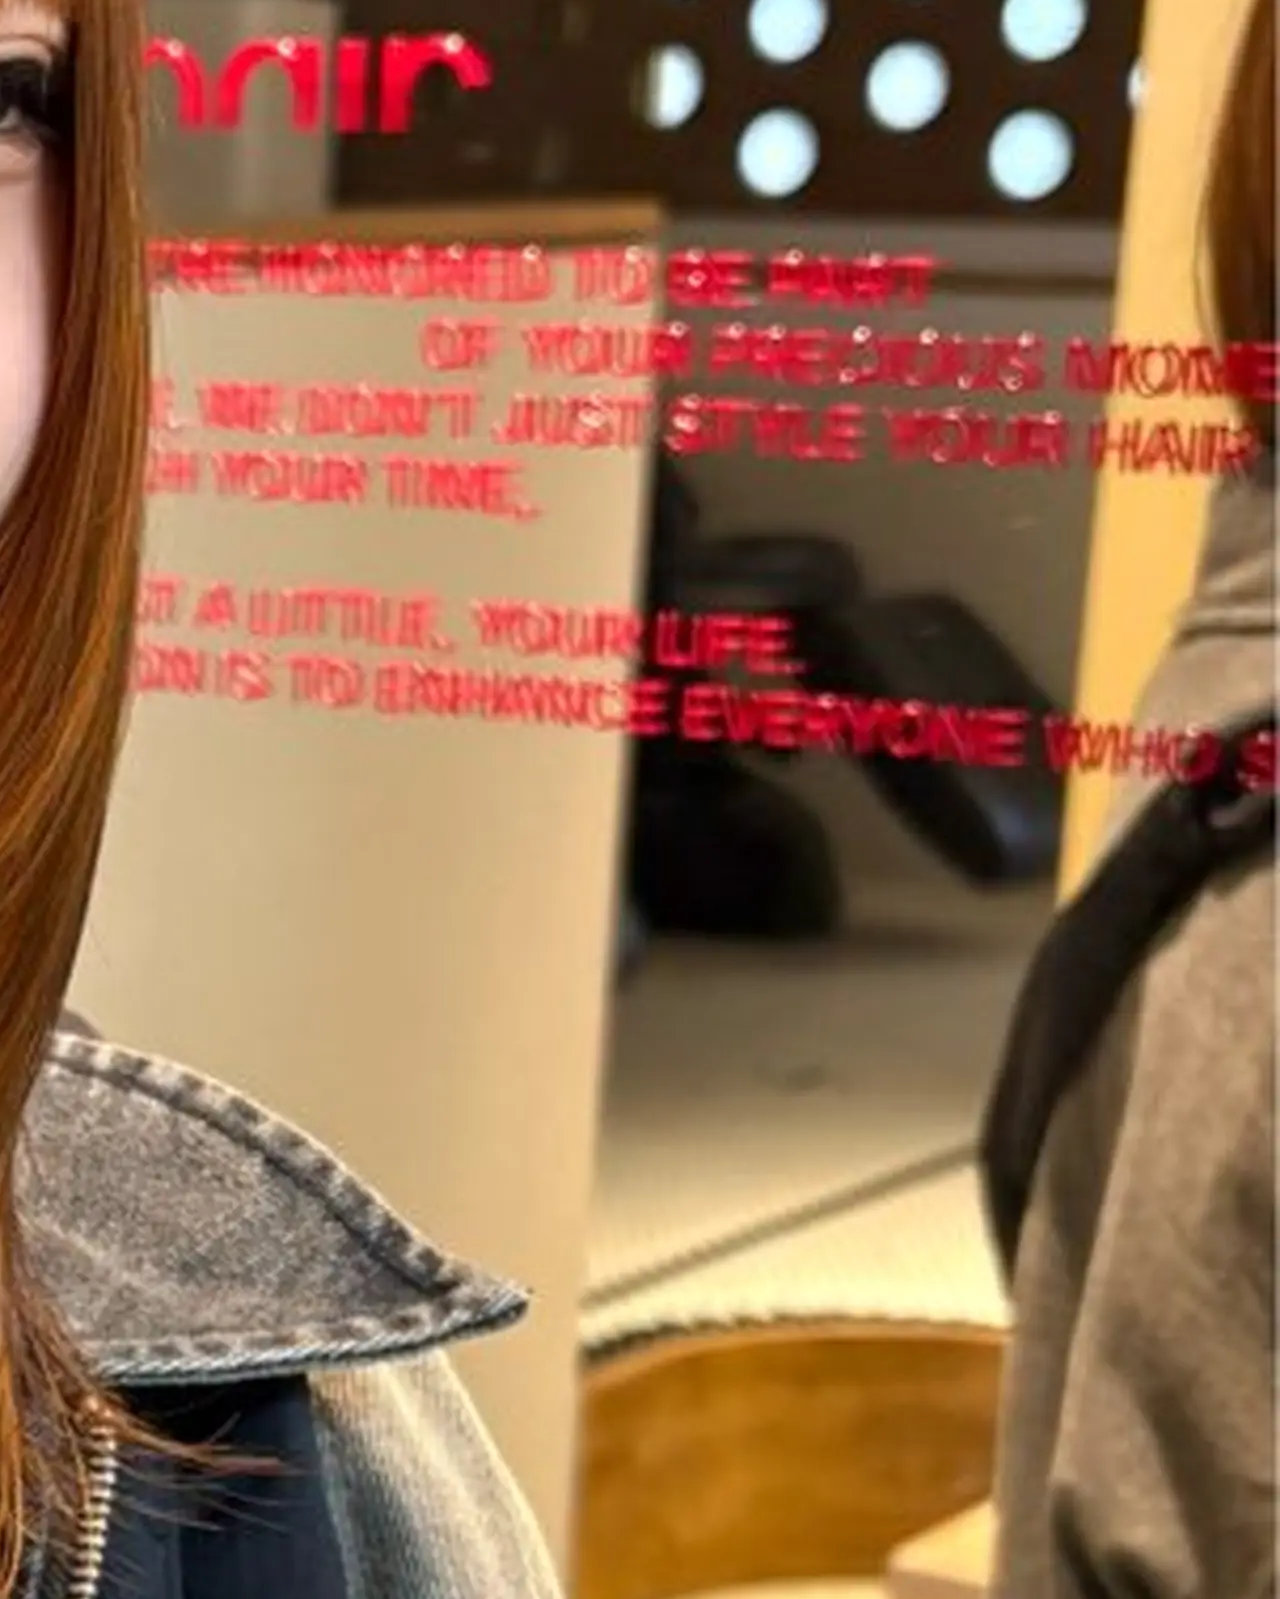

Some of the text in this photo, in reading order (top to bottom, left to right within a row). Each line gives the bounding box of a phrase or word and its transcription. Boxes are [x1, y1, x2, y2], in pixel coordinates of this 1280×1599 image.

[572, 246, 655, 305] TO
[666, 249, 754, 306] BE
[764, 250, 938, 310] PART
[422, 315, 502, 372] OF
[522, 320, 693, 378] YOUR
[708, 323, 1044, 391] PRECIOUS
[490, 392, 654, 449] JUST
[660, 395, 865, 460] STYLE
[883, 400, 1070, 468] YOUR
[210, 451, 368, 504] YOUR
[191, 580, 236, 628] A
[470, 600, 638, 658] YOUR
[286, 654, 364, 712] TO
[372, 658, 672, 736] ENHANCE
[680, 682, 1030, 768] EVERYONE
[1043, 712, 1224, 784] WHO
